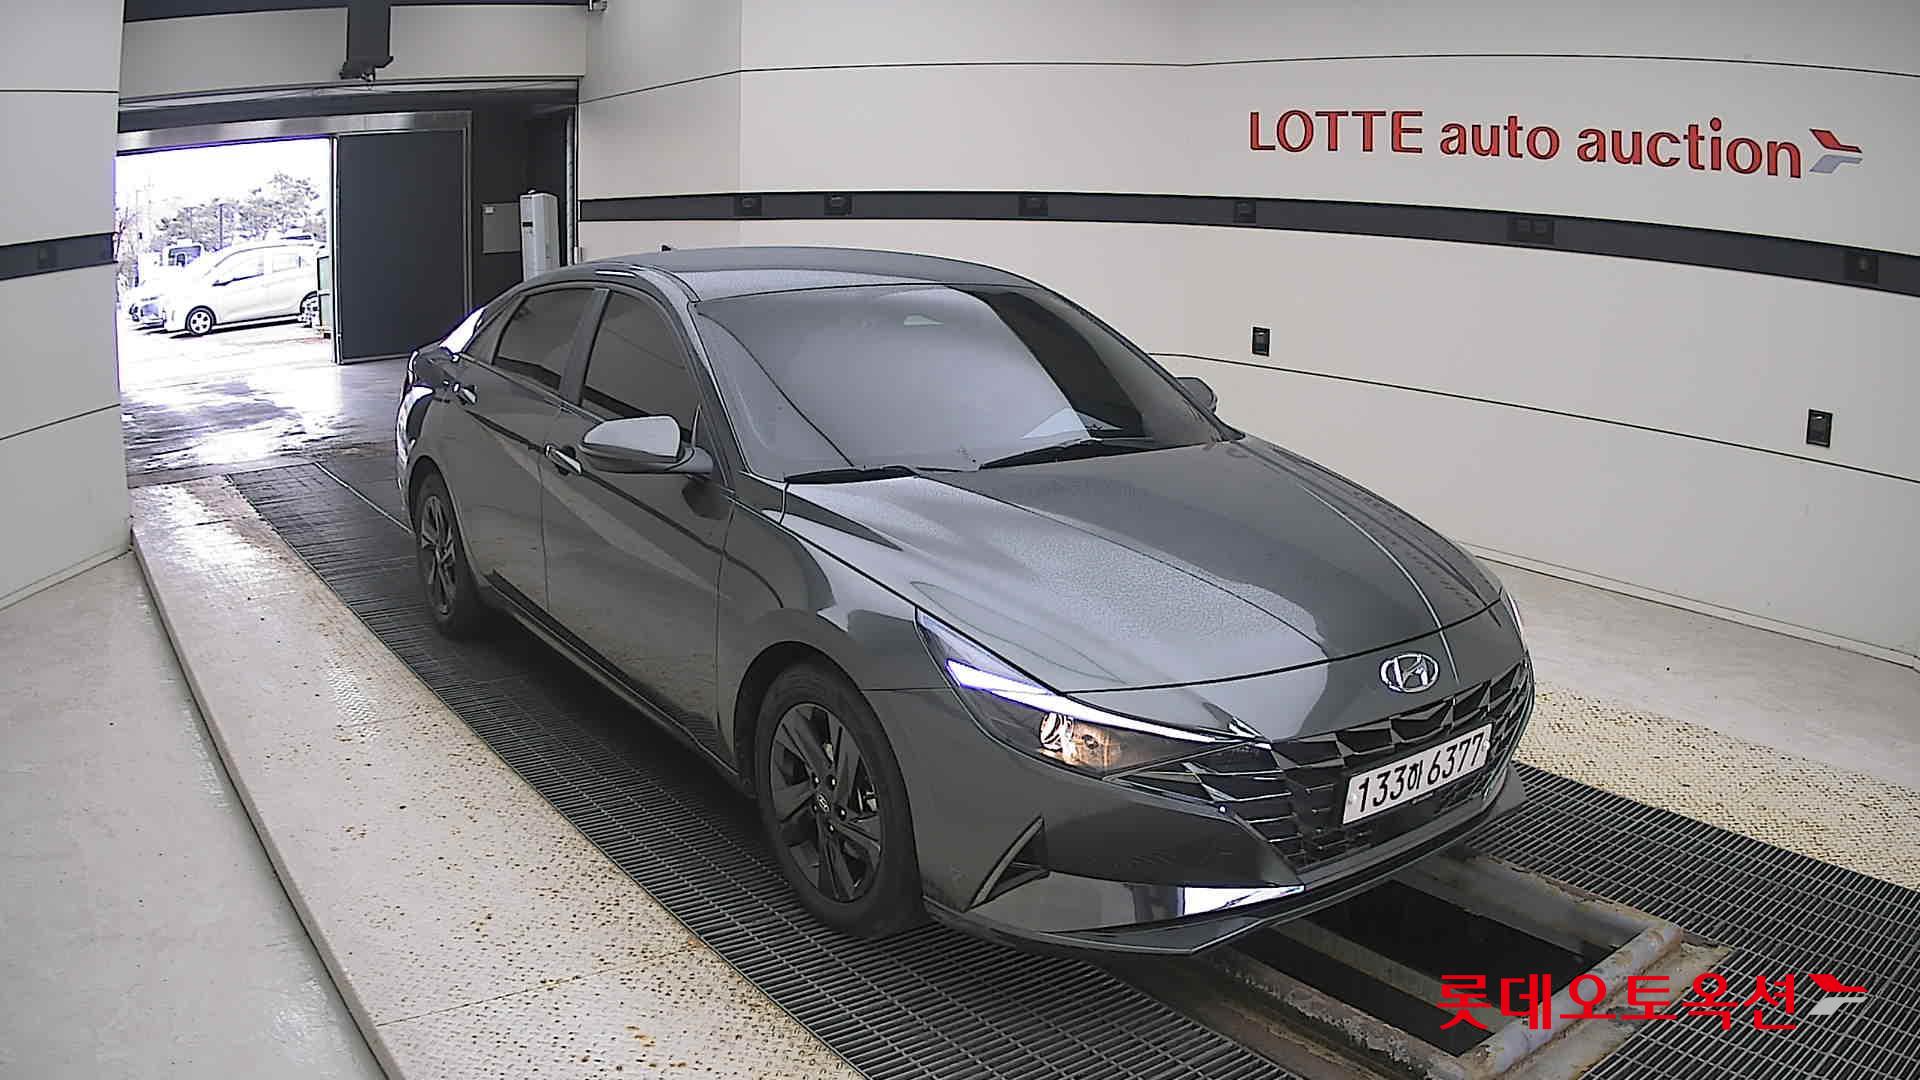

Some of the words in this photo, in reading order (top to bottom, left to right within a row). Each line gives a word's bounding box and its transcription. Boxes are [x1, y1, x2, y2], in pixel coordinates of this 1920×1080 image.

[1249, 110, 1424, 154] LOTTE
[1439, 116, 1561, 160] auto
[1575, 117, 1802, 178] auction
[1427, 733, 1484, 785] 6377
